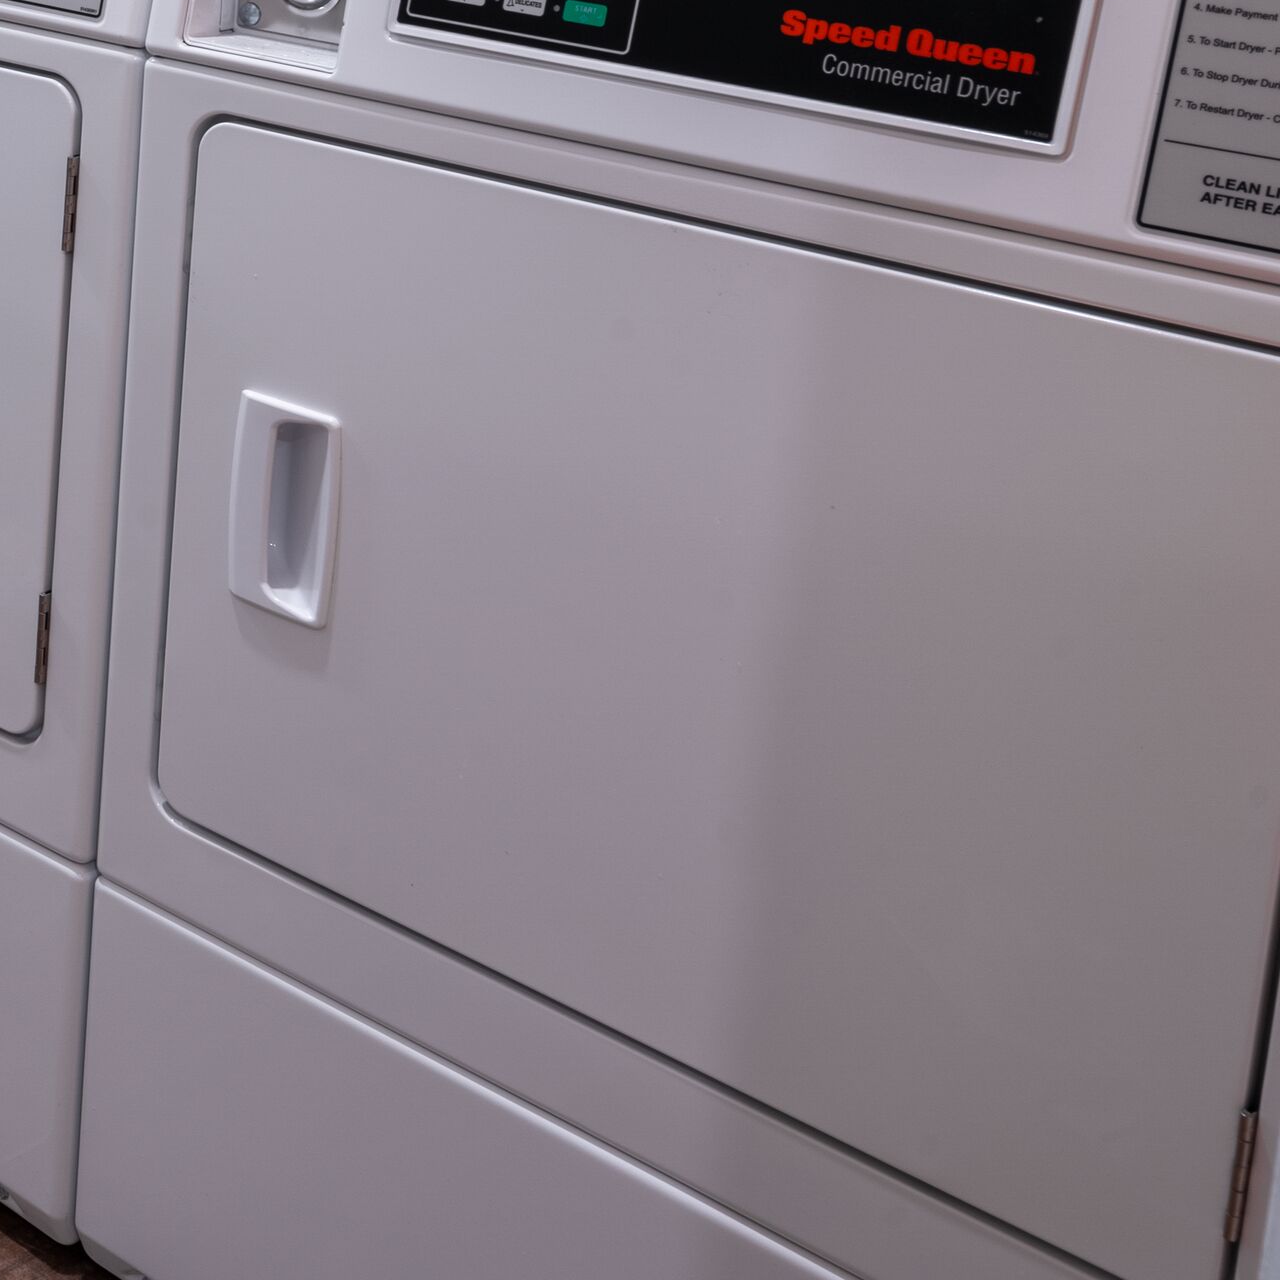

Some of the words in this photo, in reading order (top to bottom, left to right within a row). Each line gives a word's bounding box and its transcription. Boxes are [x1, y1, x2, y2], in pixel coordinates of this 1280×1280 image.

[575, 5, 597, 14] START
[1193, 3, 1203, 12] 4.
[1205, 4, 1233, 16] Make
[1234, 7, 1278, 22] Payment
[780, 9, 902, 53] Speed
[906, 28, 1036, 75] Queen
[1187, 34, 1196, 44] 5.
[1200, 36, 1211, 46] To
[1213, 37, 1237, 50] Start
[1238, 41, 1266, 54] Dryer
[822, 53, 951, 95] Commercial
[956, 76, 1022, 107] Dryer
[1180, 67, 1189, 76] 6.
[1193, 68, 1204, 78] To
[1206, 70, 1229, 82] Stop
[1231, 74, 1259, 86] Dryer
[1174, 98, 1183, 108] 7.
[1186, 100, 1197, 110] To
[1199, 102, 1235, 116] Restart
[1237, 108, 1265, 122] Dryer
[1202, 174, 1261, 195] CLEAN
[1200, 192, 1257, 212] AFTER
